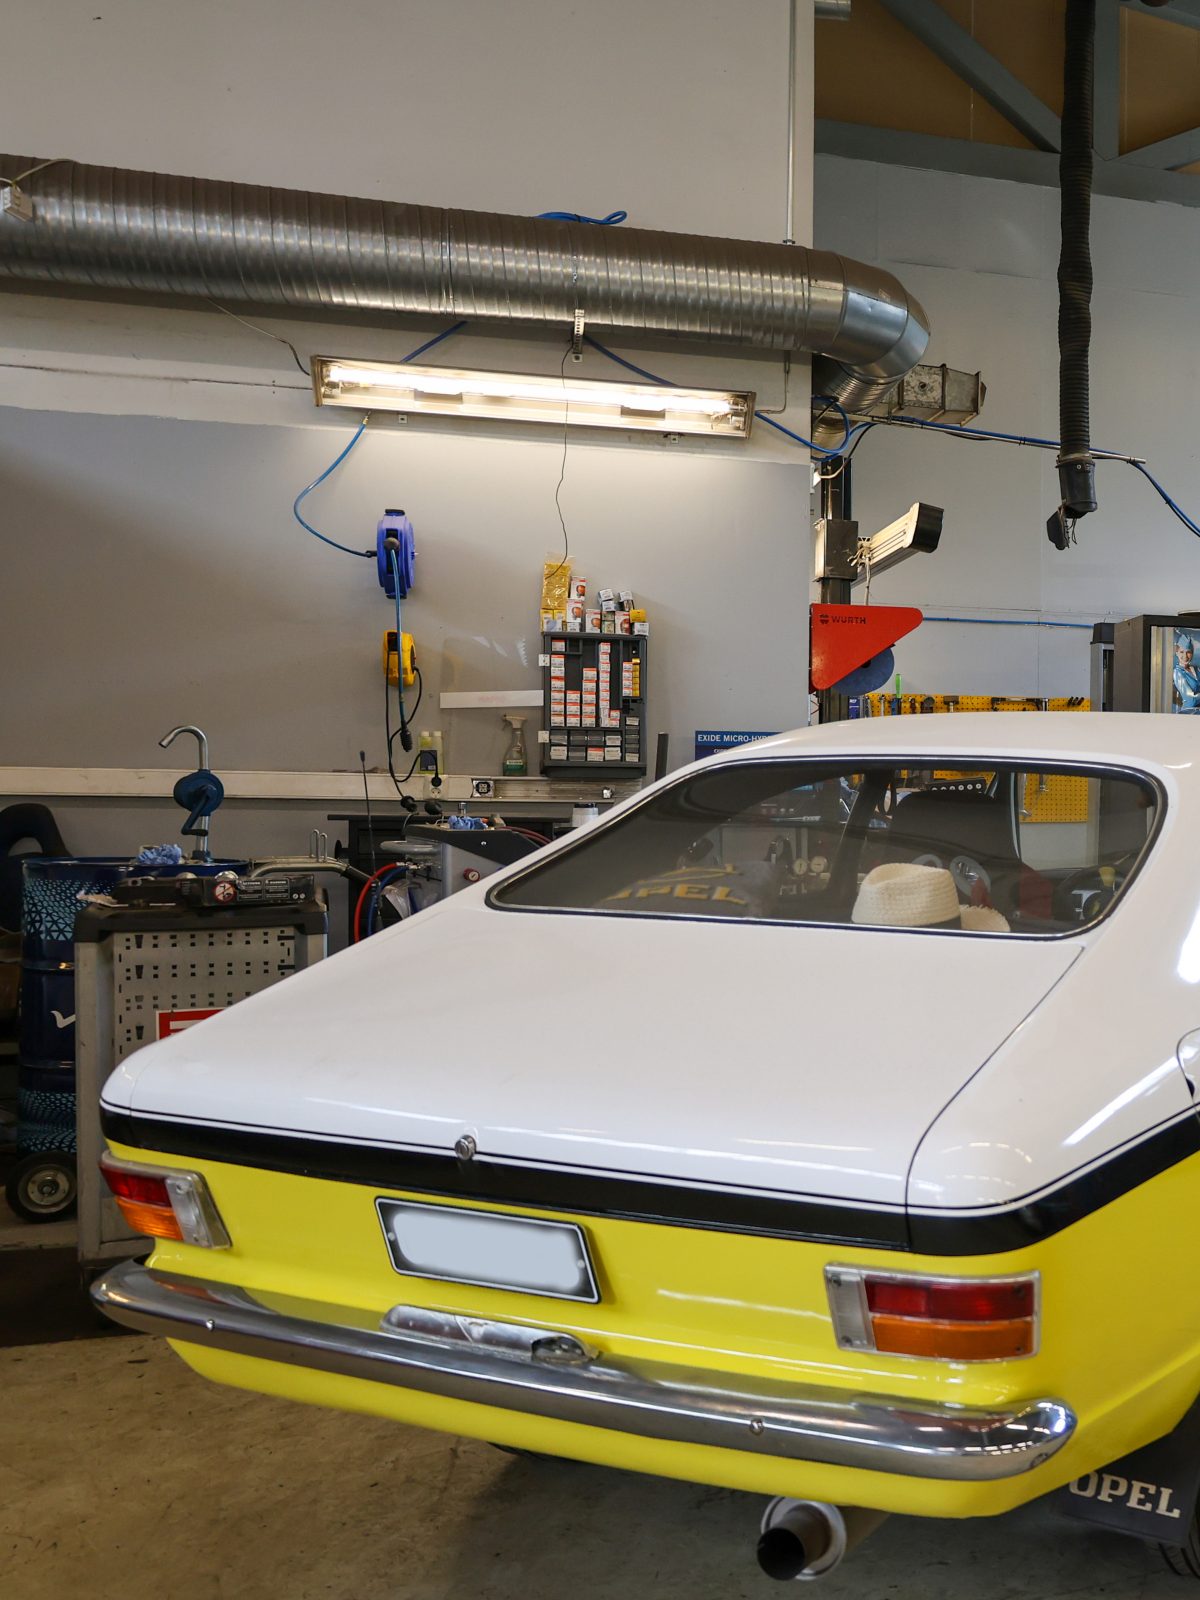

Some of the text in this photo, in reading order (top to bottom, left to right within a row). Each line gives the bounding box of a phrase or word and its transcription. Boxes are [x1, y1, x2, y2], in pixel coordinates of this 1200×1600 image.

[697, 734, 721, 742] EXIDE
[605, 883, 747, 906] PEL
[1068, 1470, 1181, 1519] OPEL
